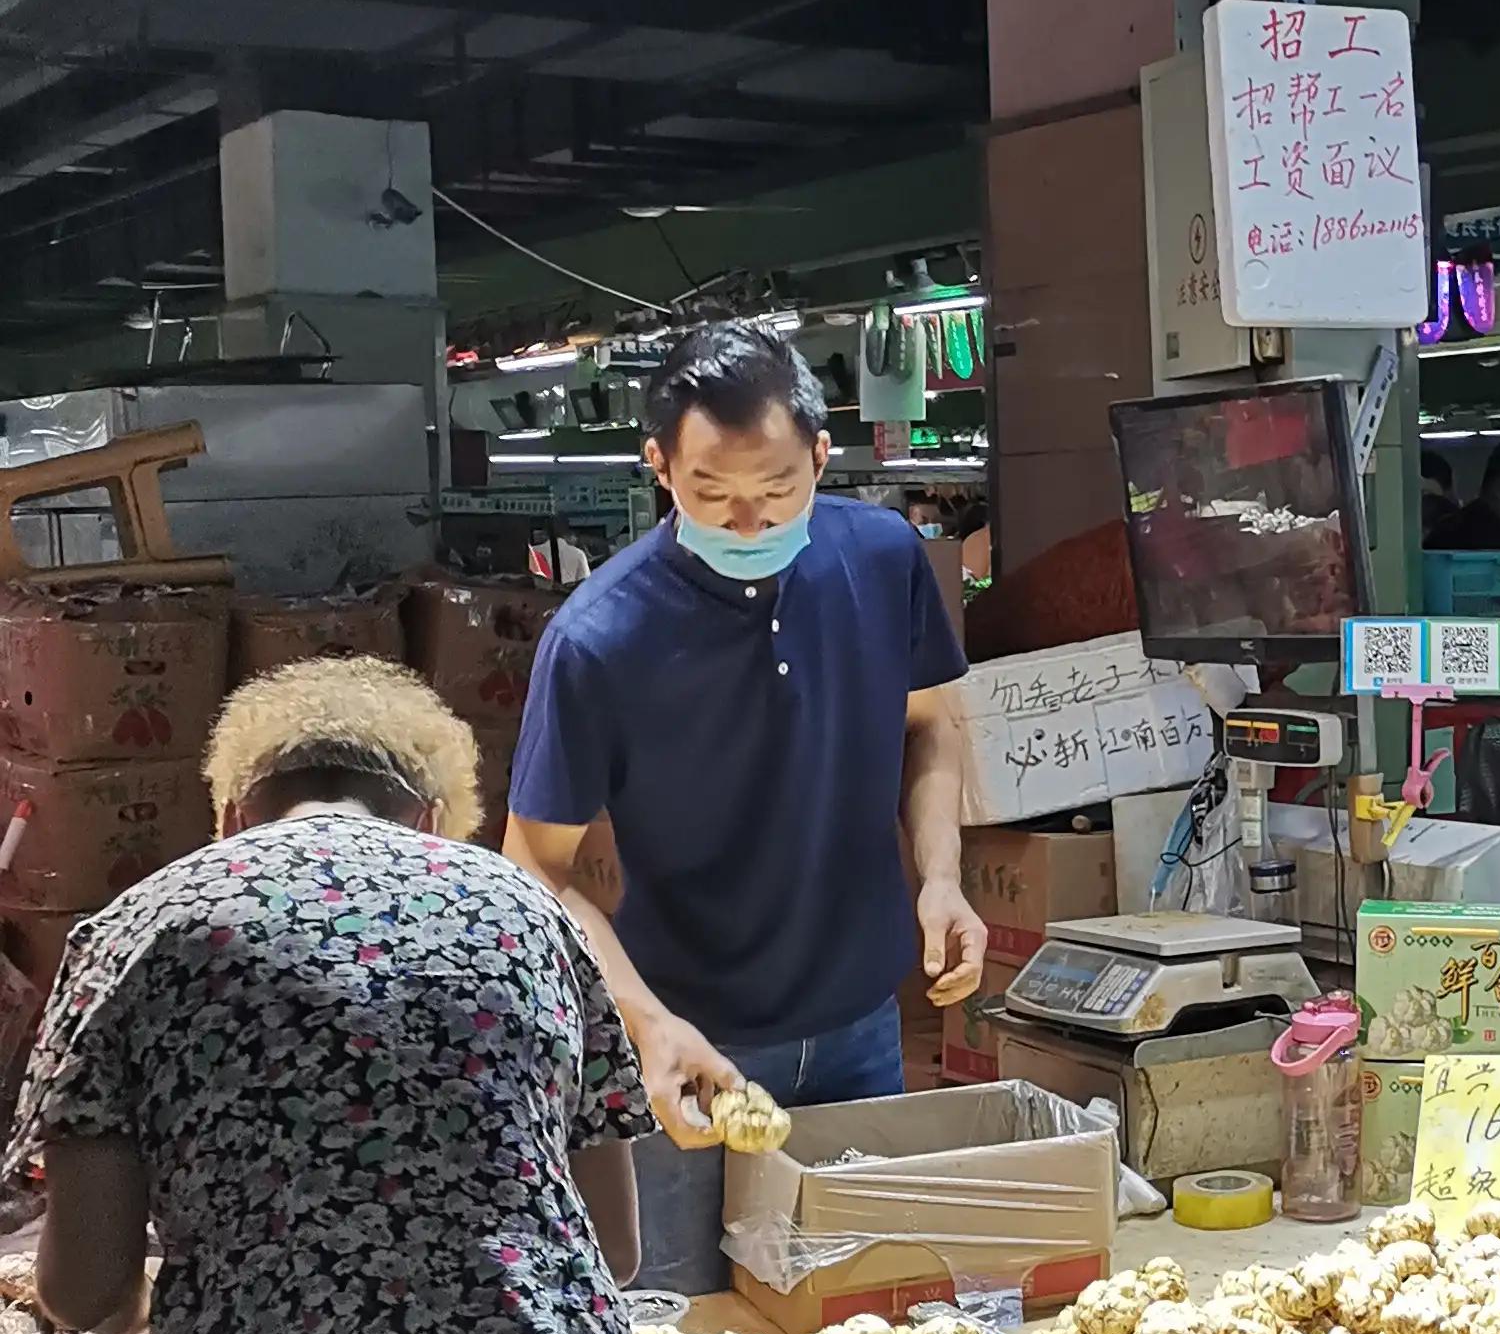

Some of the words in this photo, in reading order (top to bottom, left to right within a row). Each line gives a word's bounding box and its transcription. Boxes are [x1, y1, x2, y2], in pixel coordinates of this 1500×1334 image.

[1260, 9, 1382, 61] 招工
[1238, 136, 1414, 200] 工资面议
